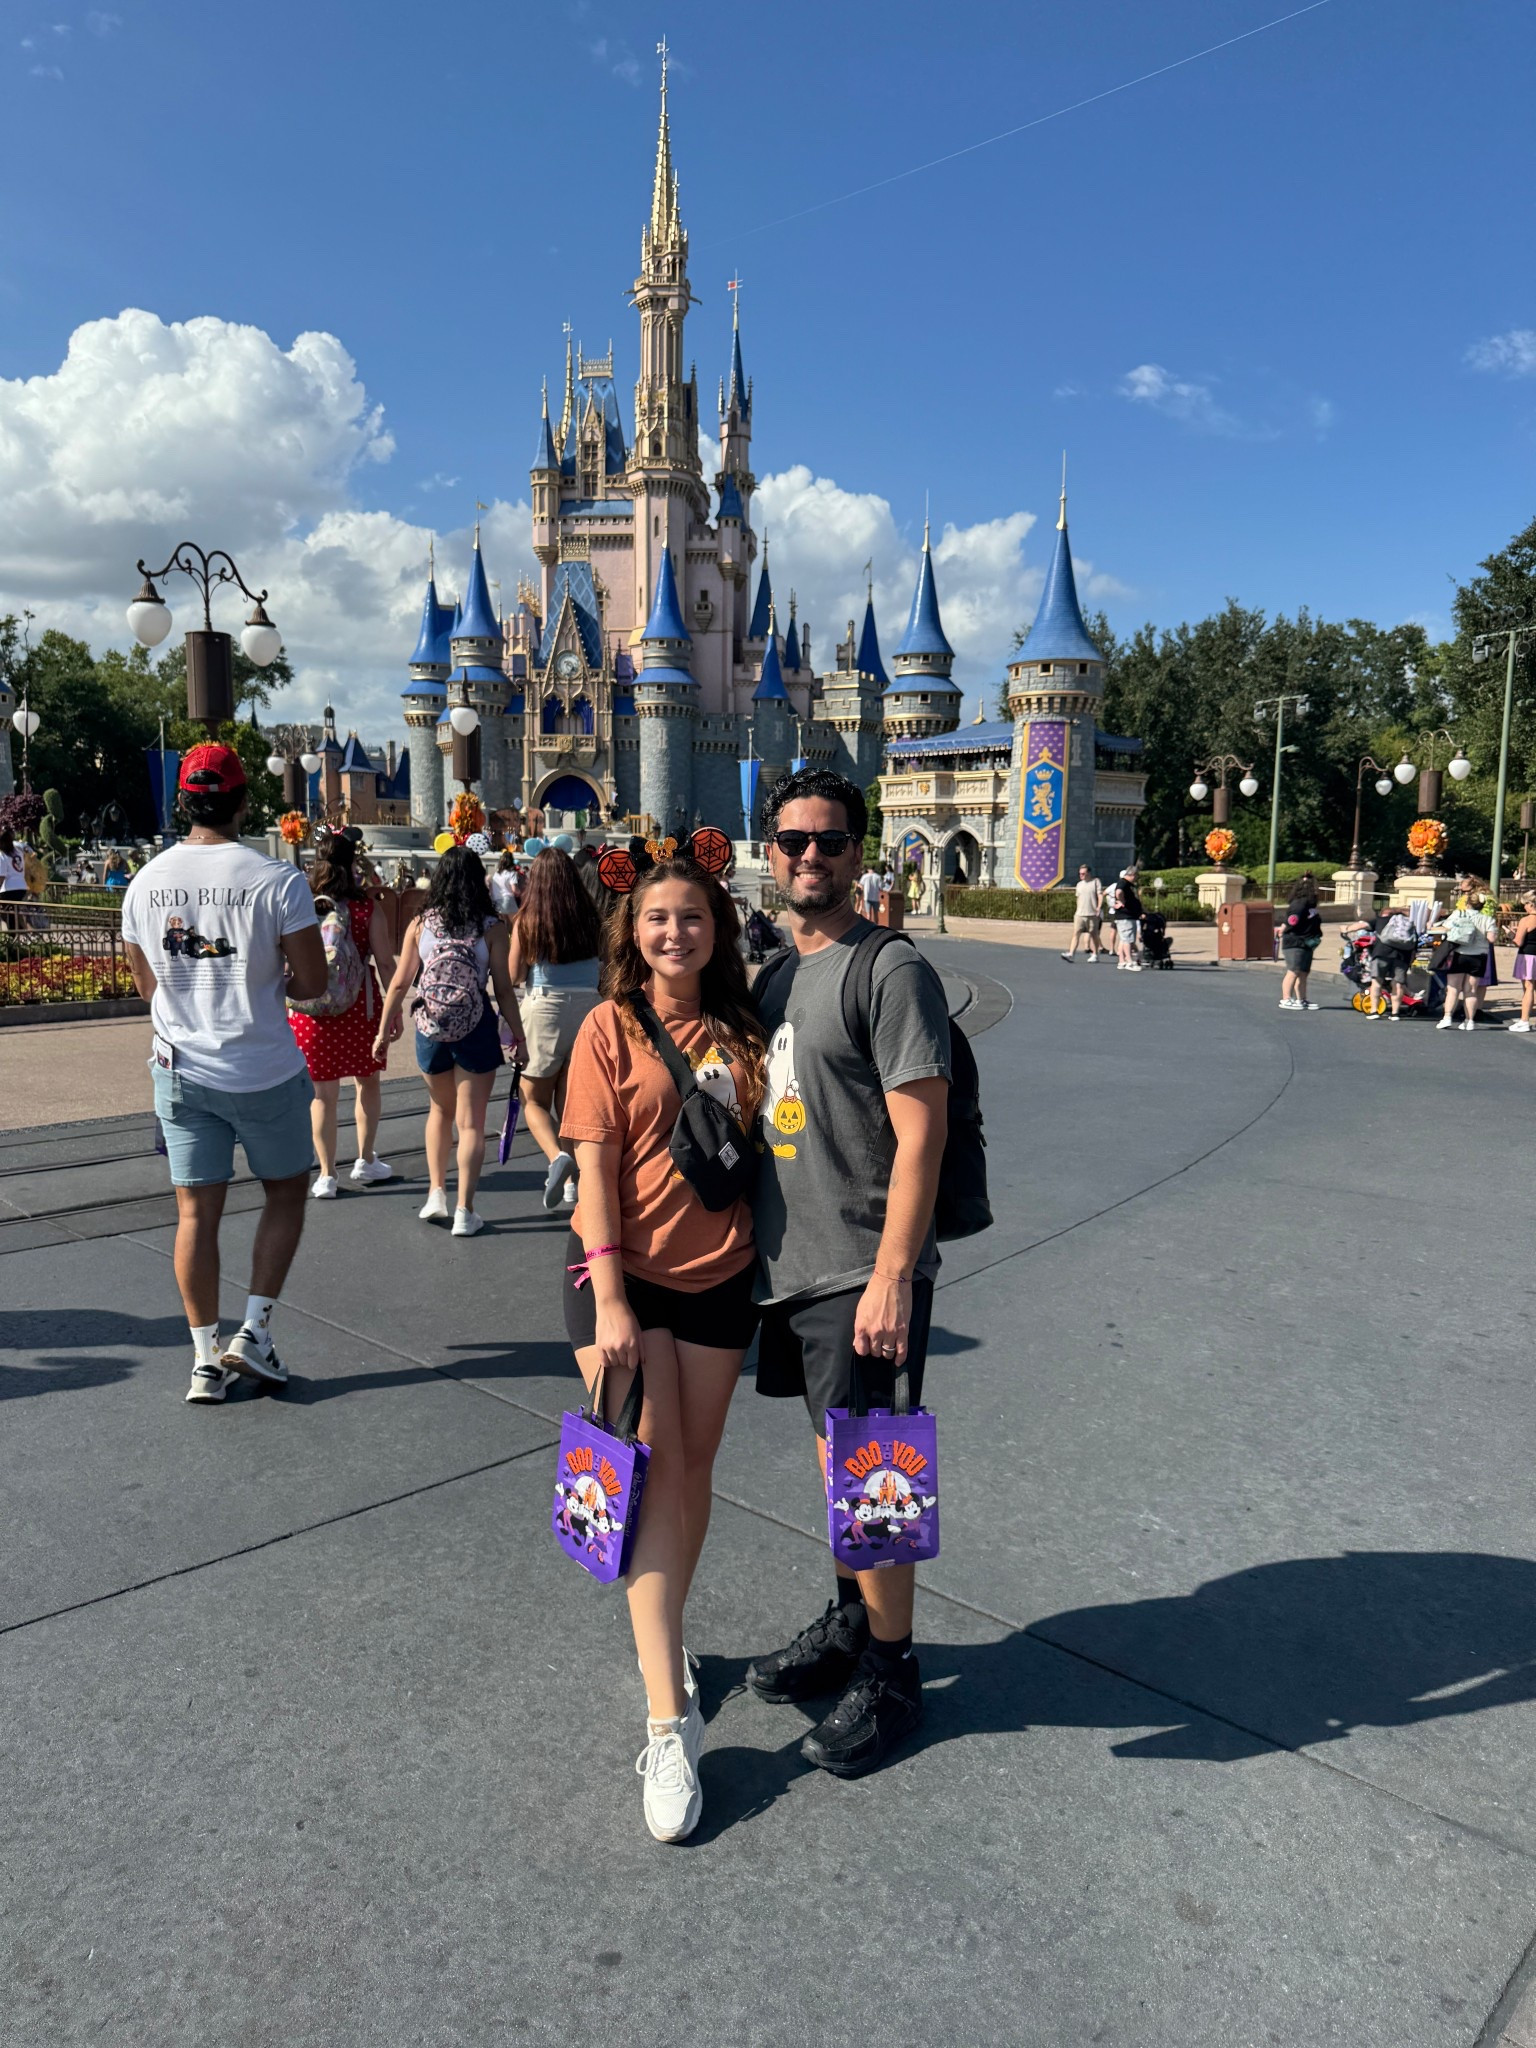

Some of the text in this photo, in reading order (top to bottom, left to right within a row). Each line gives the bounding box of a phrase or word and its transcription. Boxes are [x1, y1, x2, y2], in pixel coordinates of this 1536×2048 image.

[149, 887, 253, 908] RED BULL
[565, 1446, 593, 1475] BOO
[598, 1456, 623, 1496] YOU
[844, 1440, 883, 1479] BOO
[892, 1440, 928, 1477] YOU
